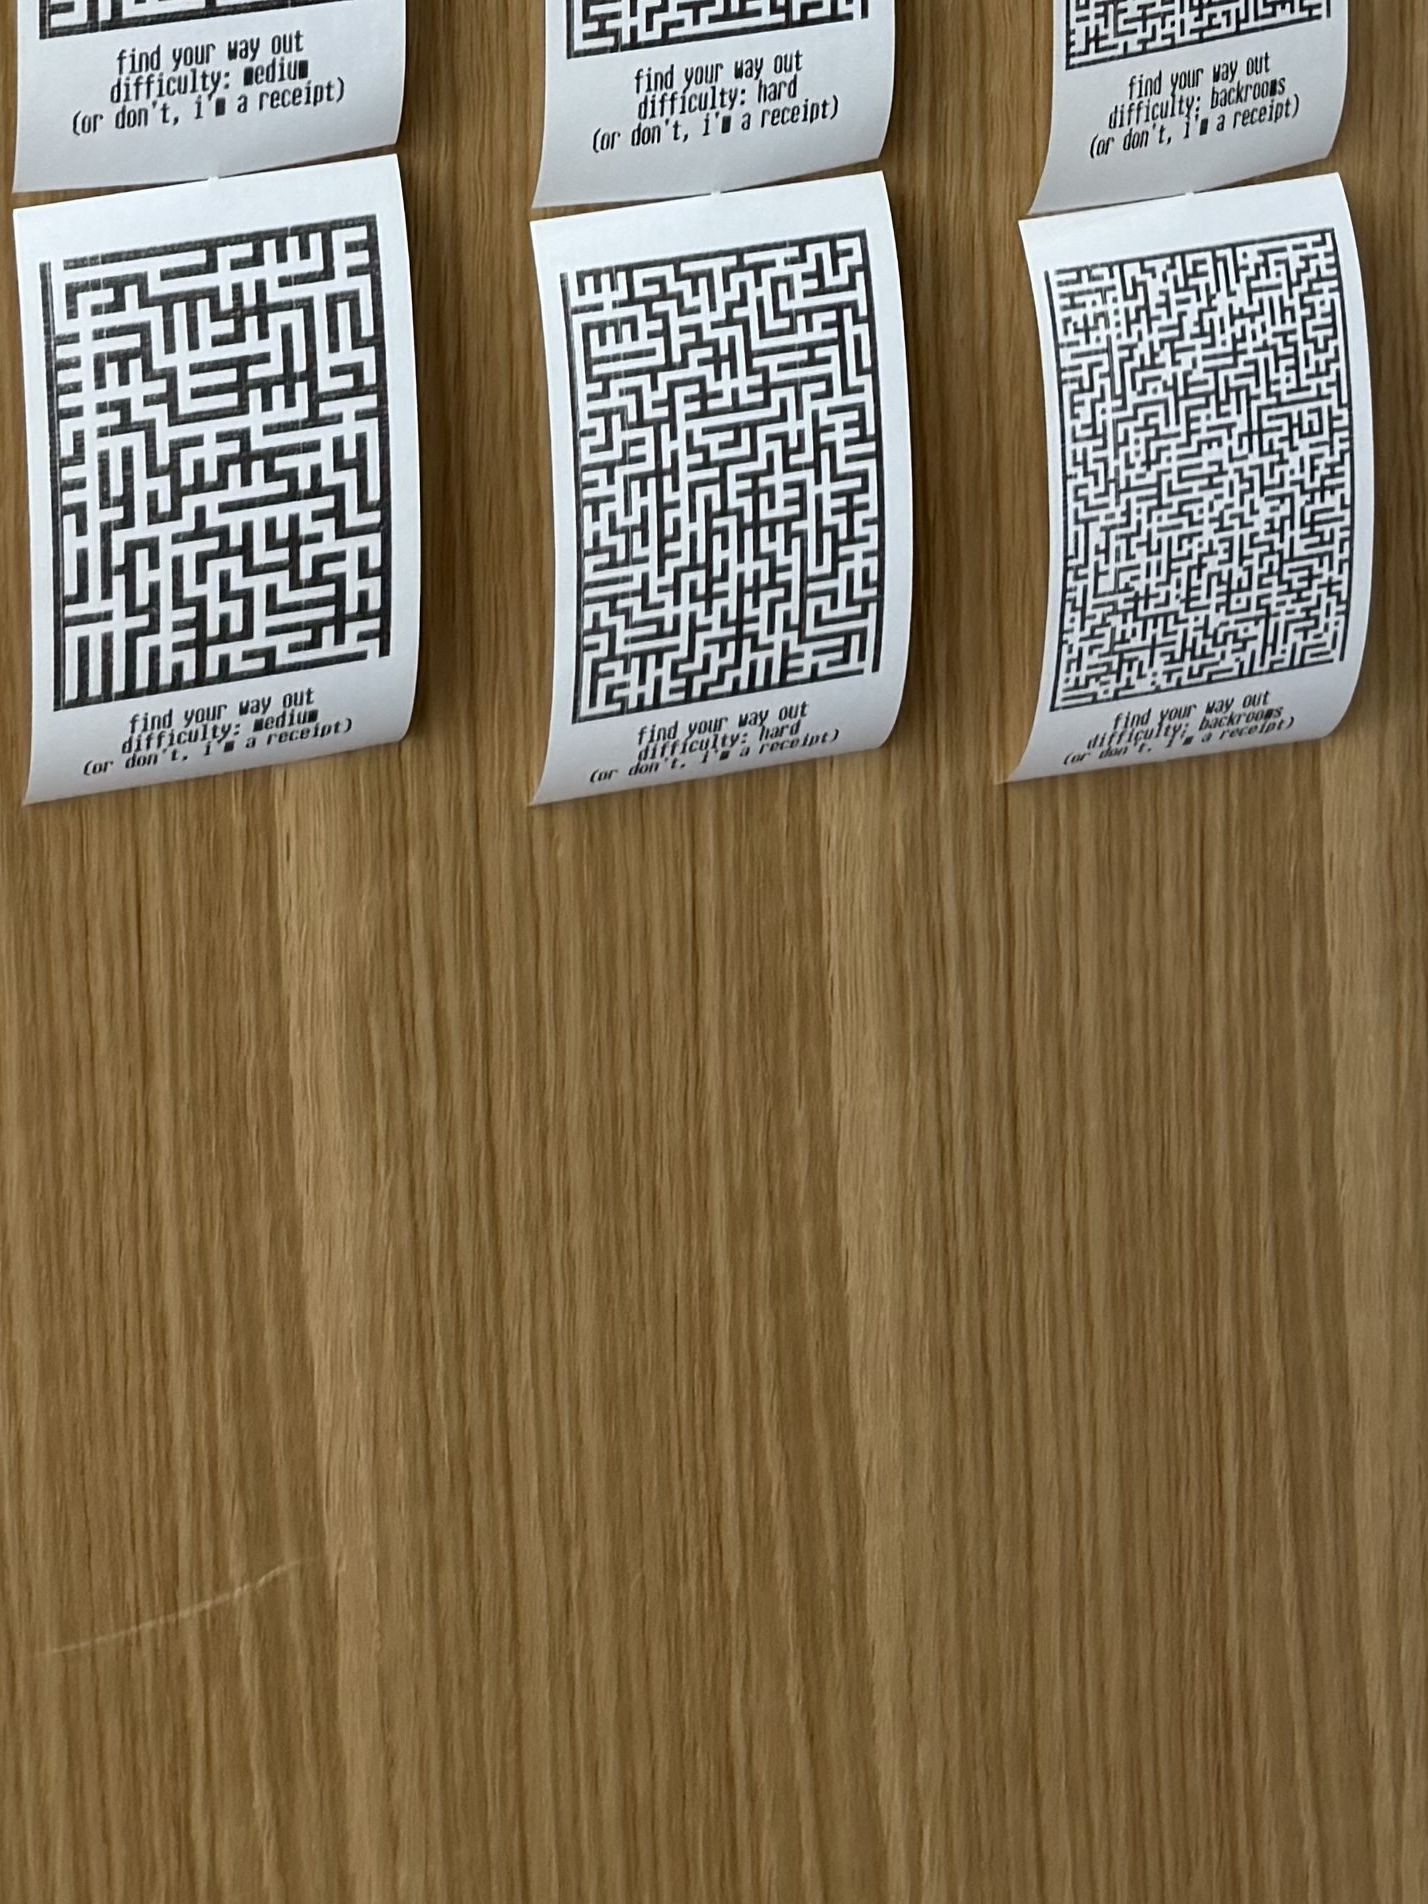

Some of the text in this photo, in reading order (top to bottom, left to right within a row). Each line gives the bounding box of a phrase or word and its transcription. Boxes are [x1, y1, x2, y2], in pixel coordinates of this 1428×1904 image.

[117, 30, 303, 76] find your way out
[635, 50, 803, 94] find your way out
[638, 73, 797, 120] difficulty: hard
[1129, 52, 1270, 100] find your way out
[129, 708, 173, 735] find
[184, 704, 227, 728] your
[283, 688, 314, 710] out
[638, 720, 678, 746] find
[688, 717, 728, 739] your
[778, 701, 809, 721] out
[1113, 707, 1151, 731] find
[1160, 704, 1197, 726] your
[1242, 690, 1270, 709] out
[638, 718, 801, 762] difficulty: hard
